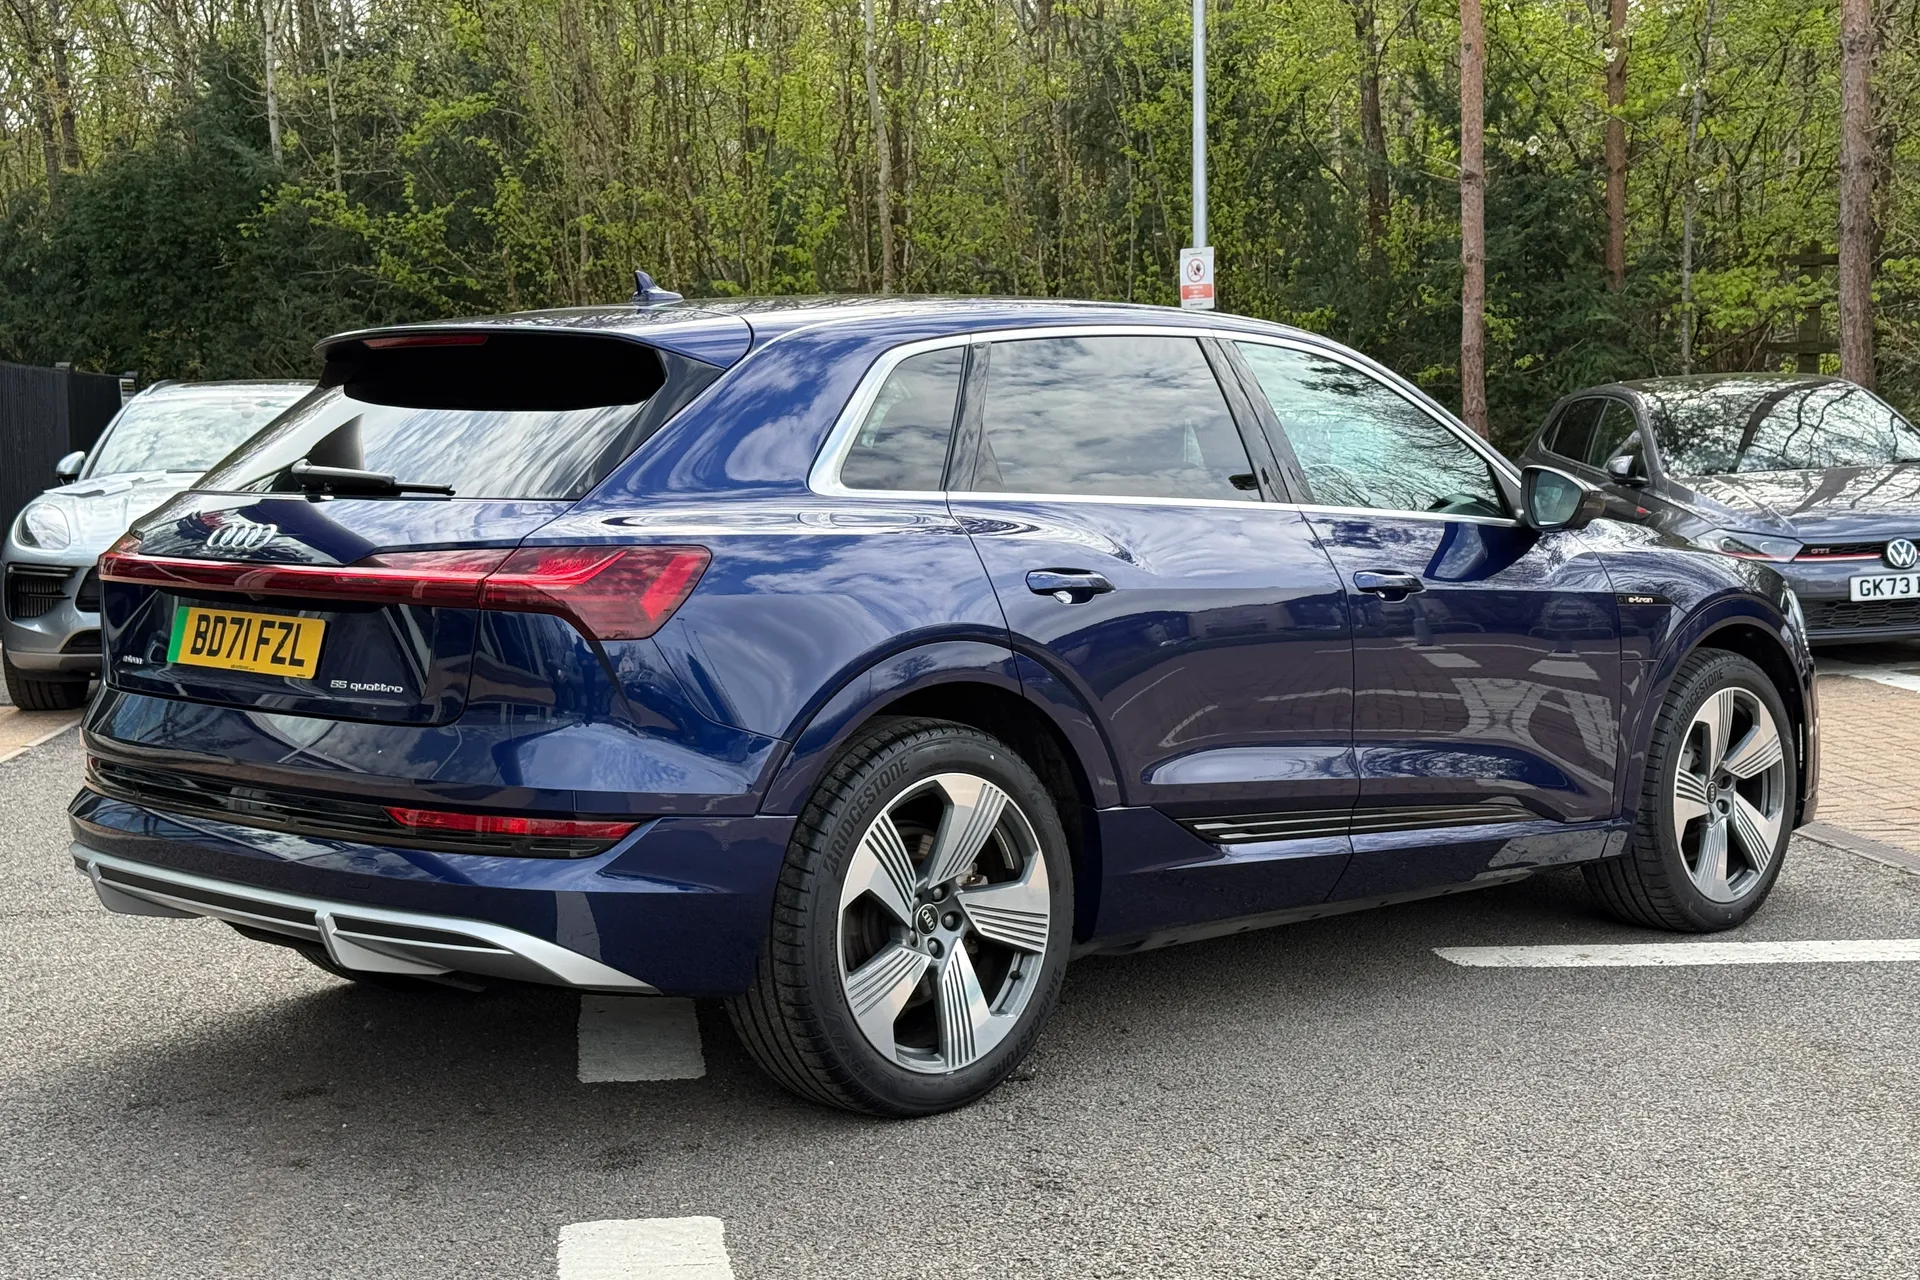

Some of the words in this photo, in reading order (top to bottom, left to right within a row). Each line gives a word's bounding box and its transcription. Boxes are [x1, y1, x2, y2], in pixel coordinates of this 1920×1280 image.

[1810, 547, 1830, 555] GTI
[1859, 576, 1911, 597] GK73
[1627, 595, 1654, 604] e-tron
[189, 613, 253, 661] BD71
[252, 619, 306, 668] FZL
[330, 679, 348, 689] 55
[350, 682, 404, 694] quattro
[1674, 668, 1724, 738] BRIDGESTONE
[822, 756, 910, 877] BRIDGESTONE
